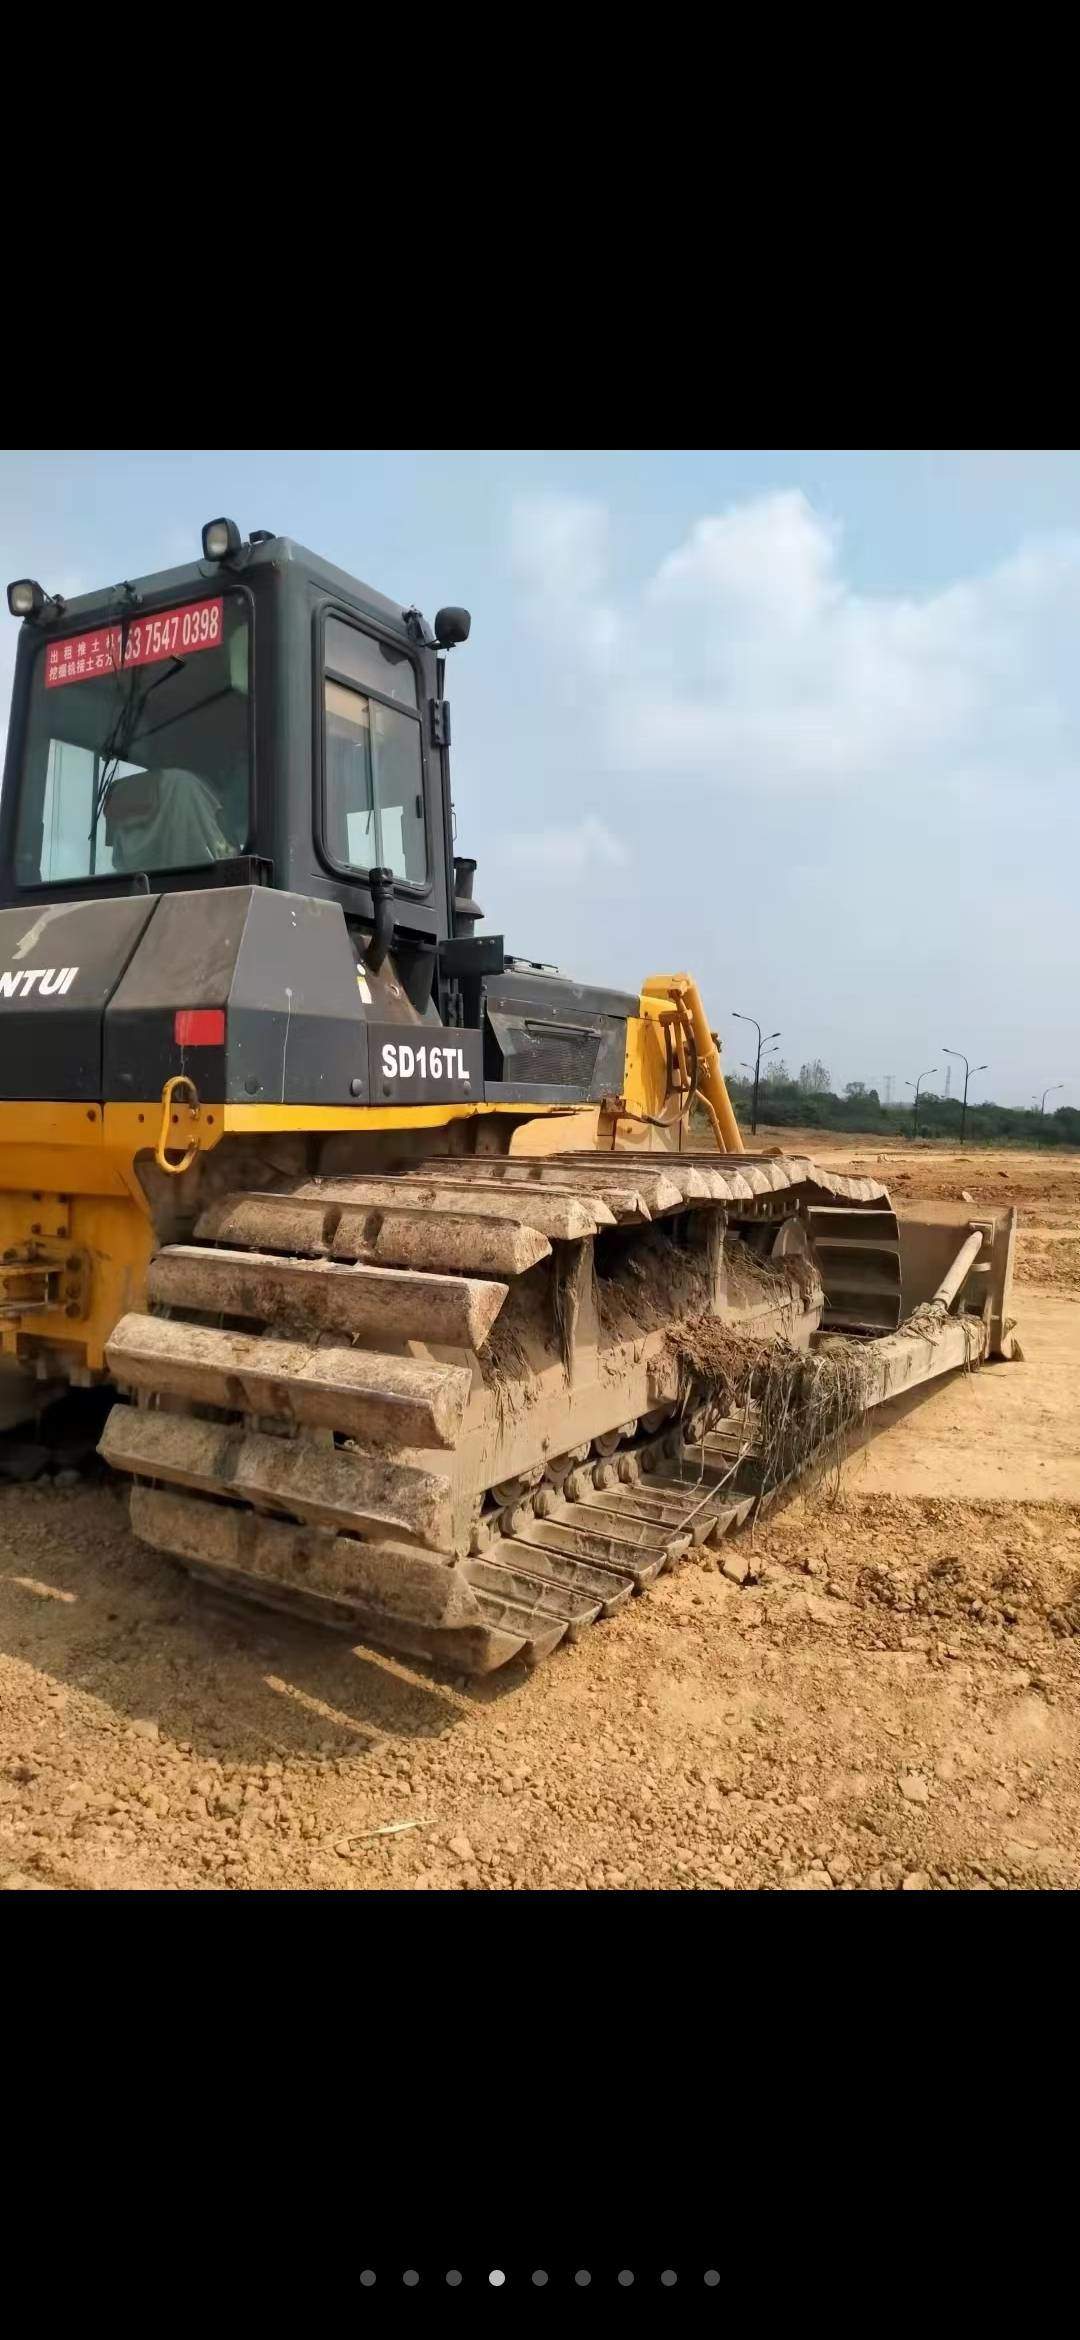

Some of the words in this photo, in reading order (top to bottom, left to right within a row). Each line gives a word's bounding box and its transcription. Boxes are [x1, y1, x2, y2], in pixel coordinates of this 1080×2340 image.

[145, 616, 179, 655] 7547
[182, 606, 219, 646] 0398
[382, 1044, 470, 1079] SD16TL
